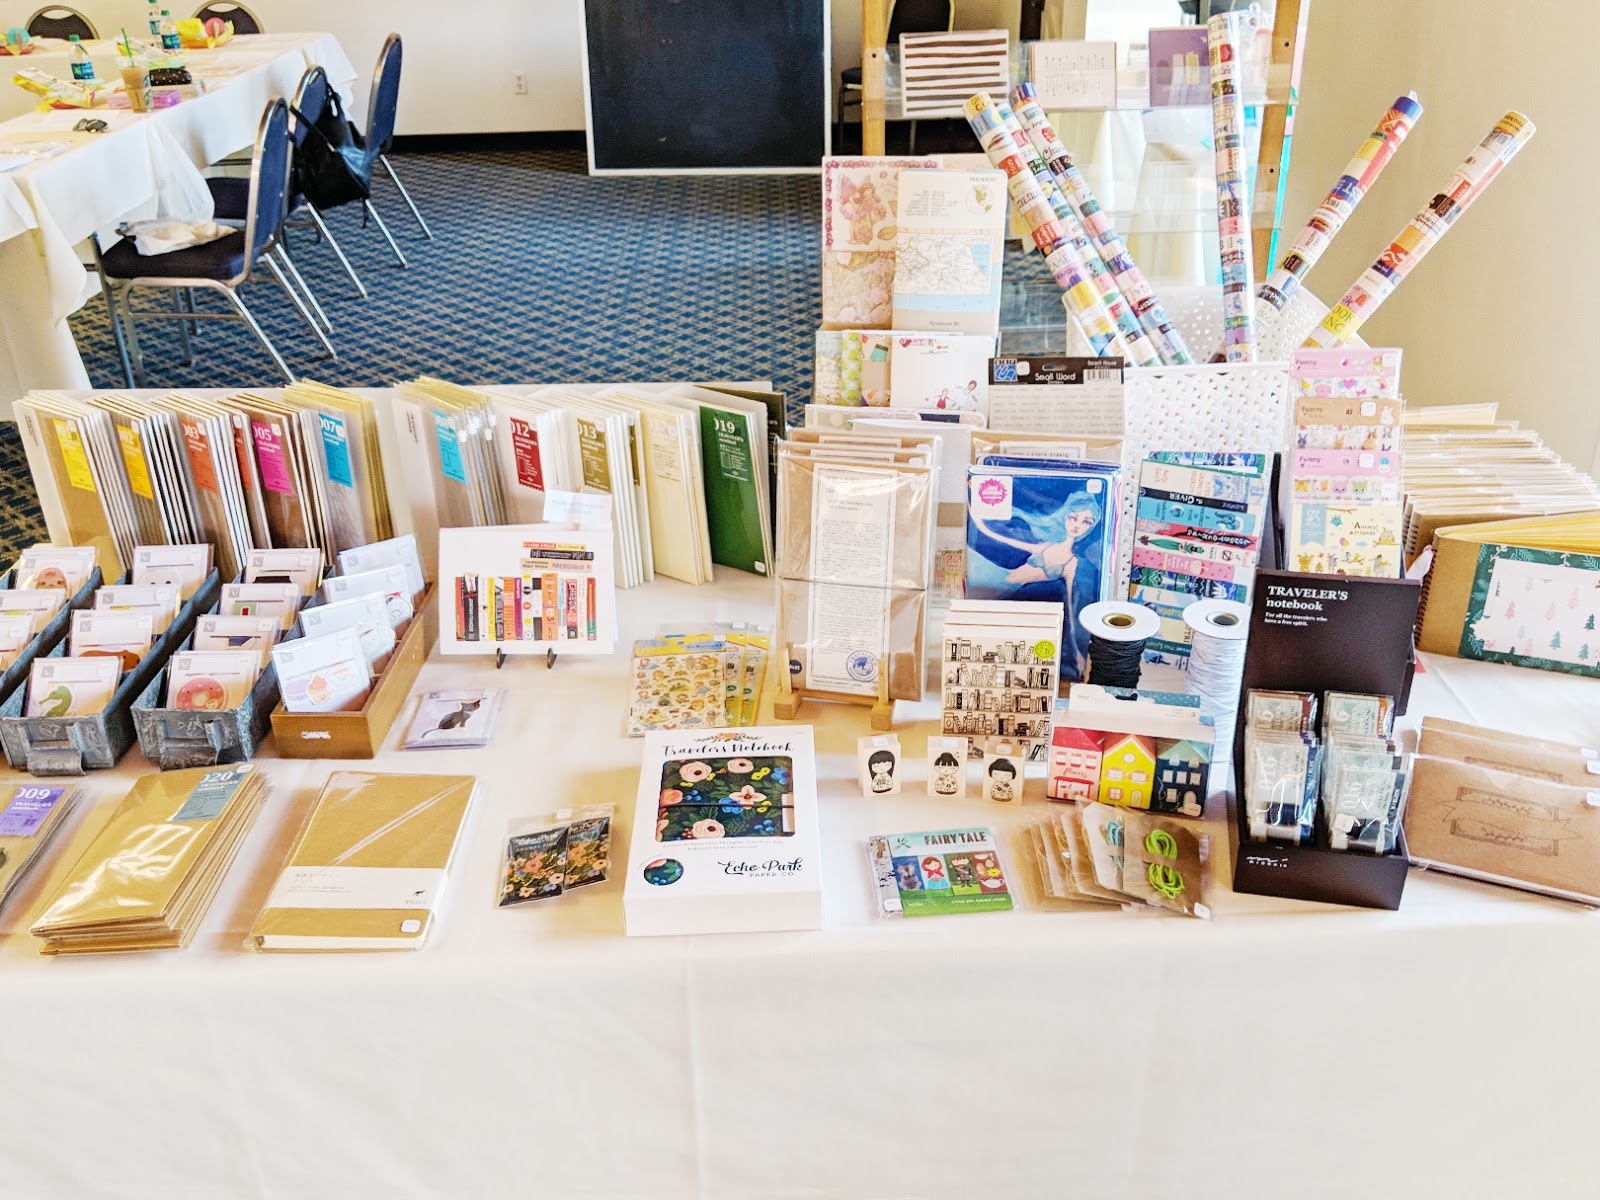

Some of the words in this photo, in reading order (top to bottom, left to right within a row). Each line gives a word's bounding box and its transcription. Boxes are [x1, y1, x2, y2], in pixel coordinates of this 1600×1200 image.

[1034, 372, 1054, 381] Small
[1055, 372, 1076, 380] Word
[1268, 585, 1348, 601] TRAVELER'S
[1266, 598, 1324, 611] notebook
[732, 742, 794, 752] Notebook
[1062, 767, 1087, 778] flowers
[924, 833, 958, 845] FAIRY
[960, 832, 987, 842] TALE
[718, 861, 759, 876] Echo
[762, 857, 804, 872] Park
